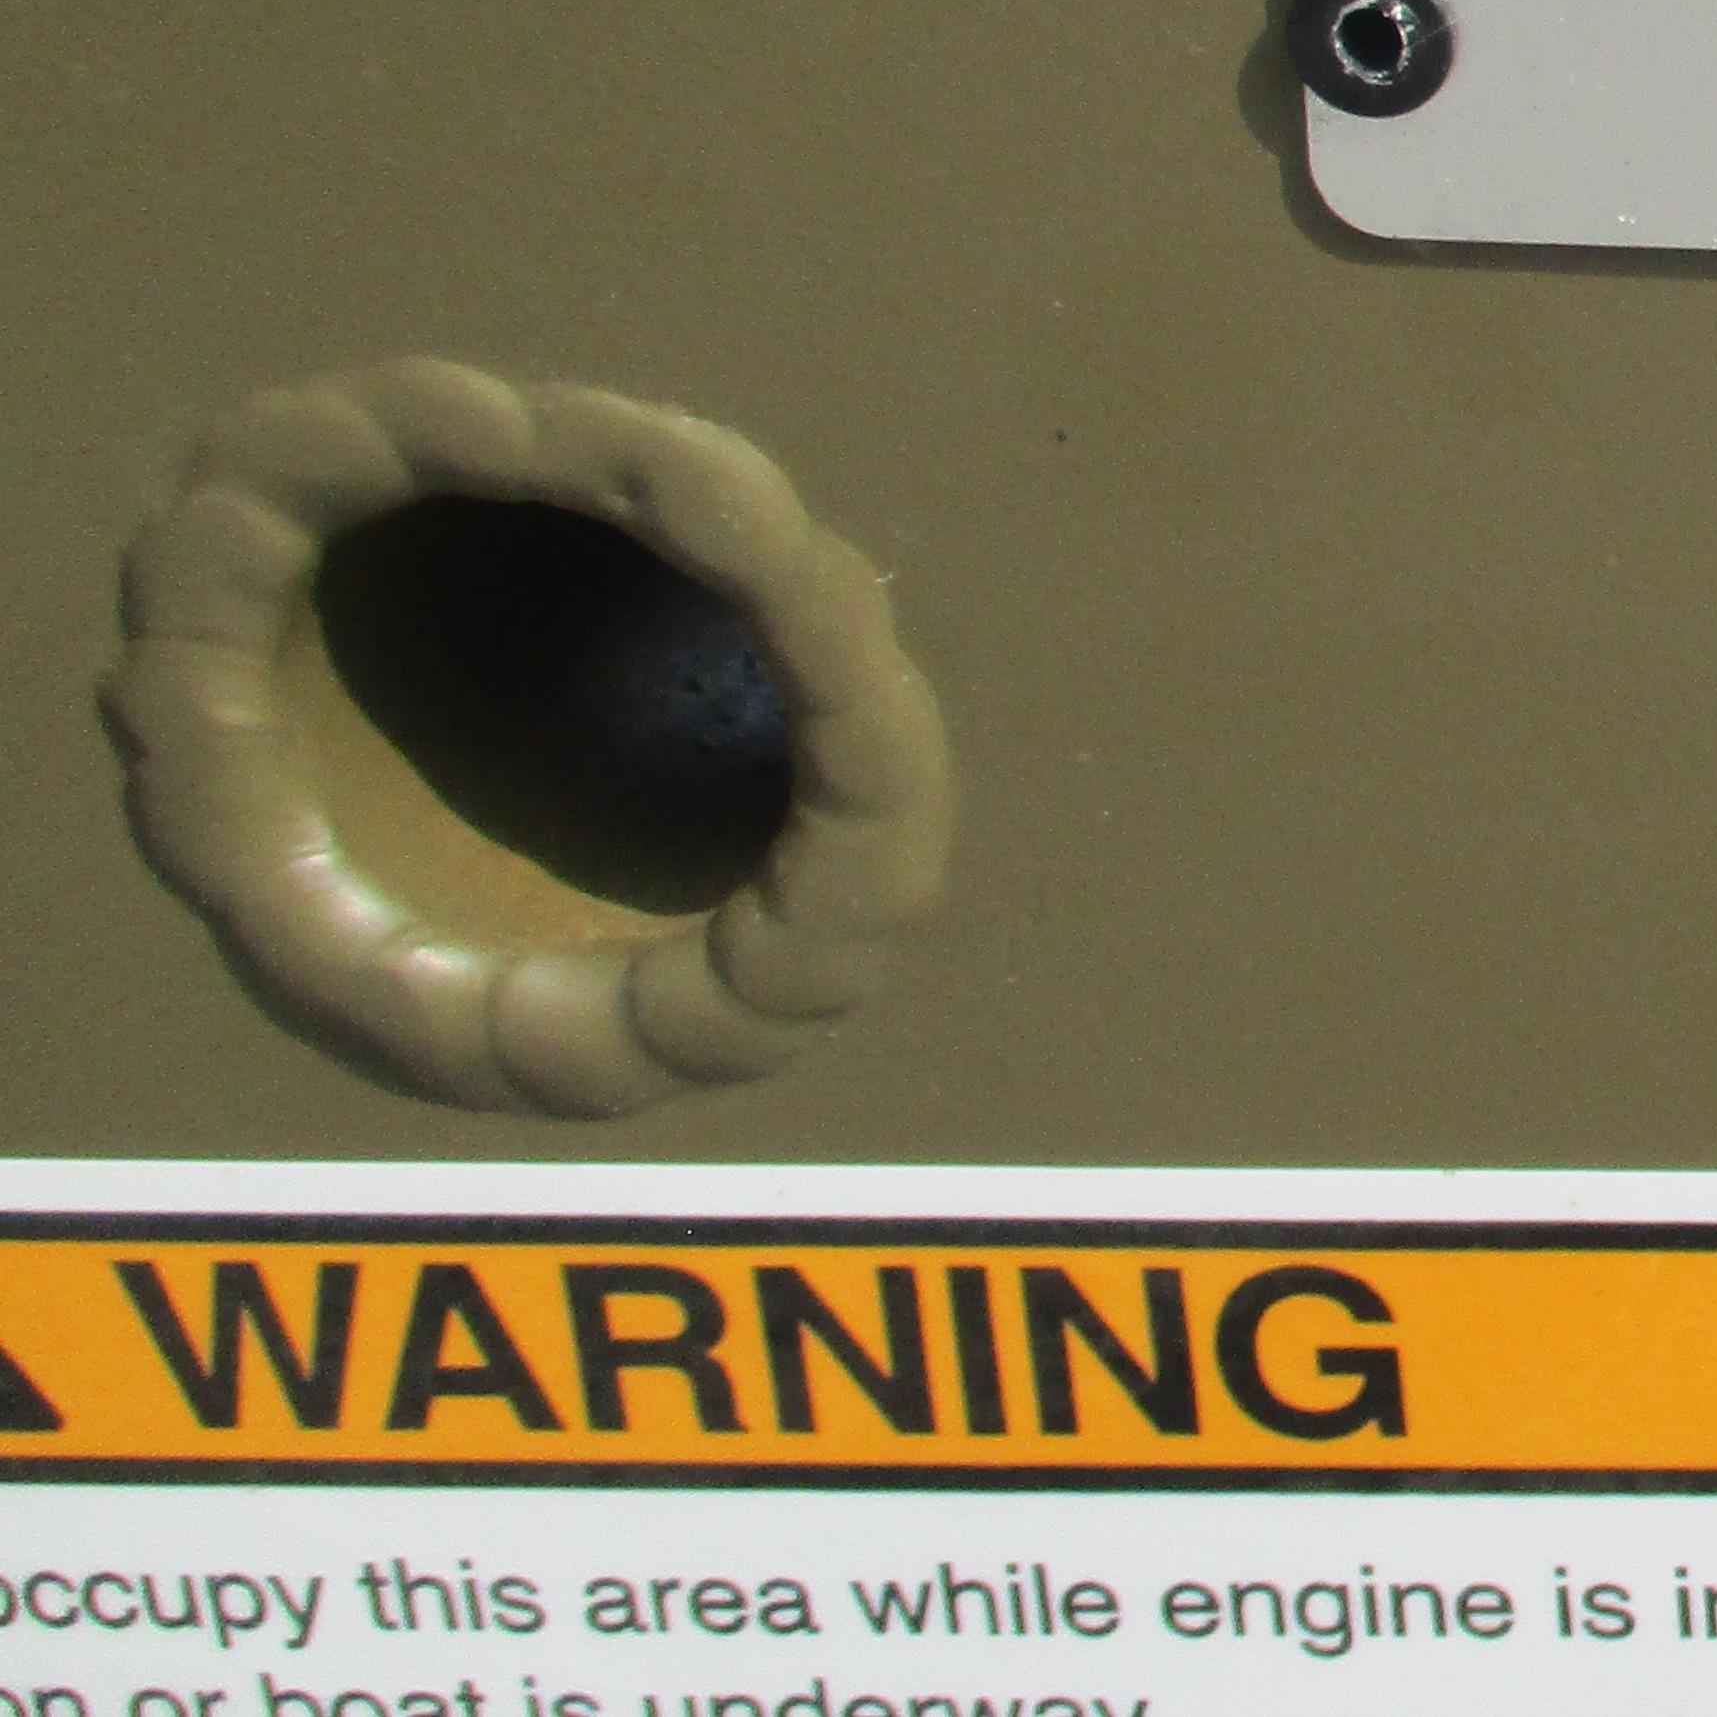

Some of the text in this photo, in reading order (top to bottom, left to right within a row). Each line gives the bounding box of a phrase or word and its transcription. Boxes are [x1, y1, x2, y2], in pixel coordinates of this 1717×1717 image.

[114, 1258, 1410, 1444] WARNING
[356, 1556, 547, 1635] this
[583, 1575, 822, 1637] area
[849, 1560, 1121, 1638] while
[1160, 1563, 1516, 1660] engine
[1553, 1564, 1638, 1641] is
